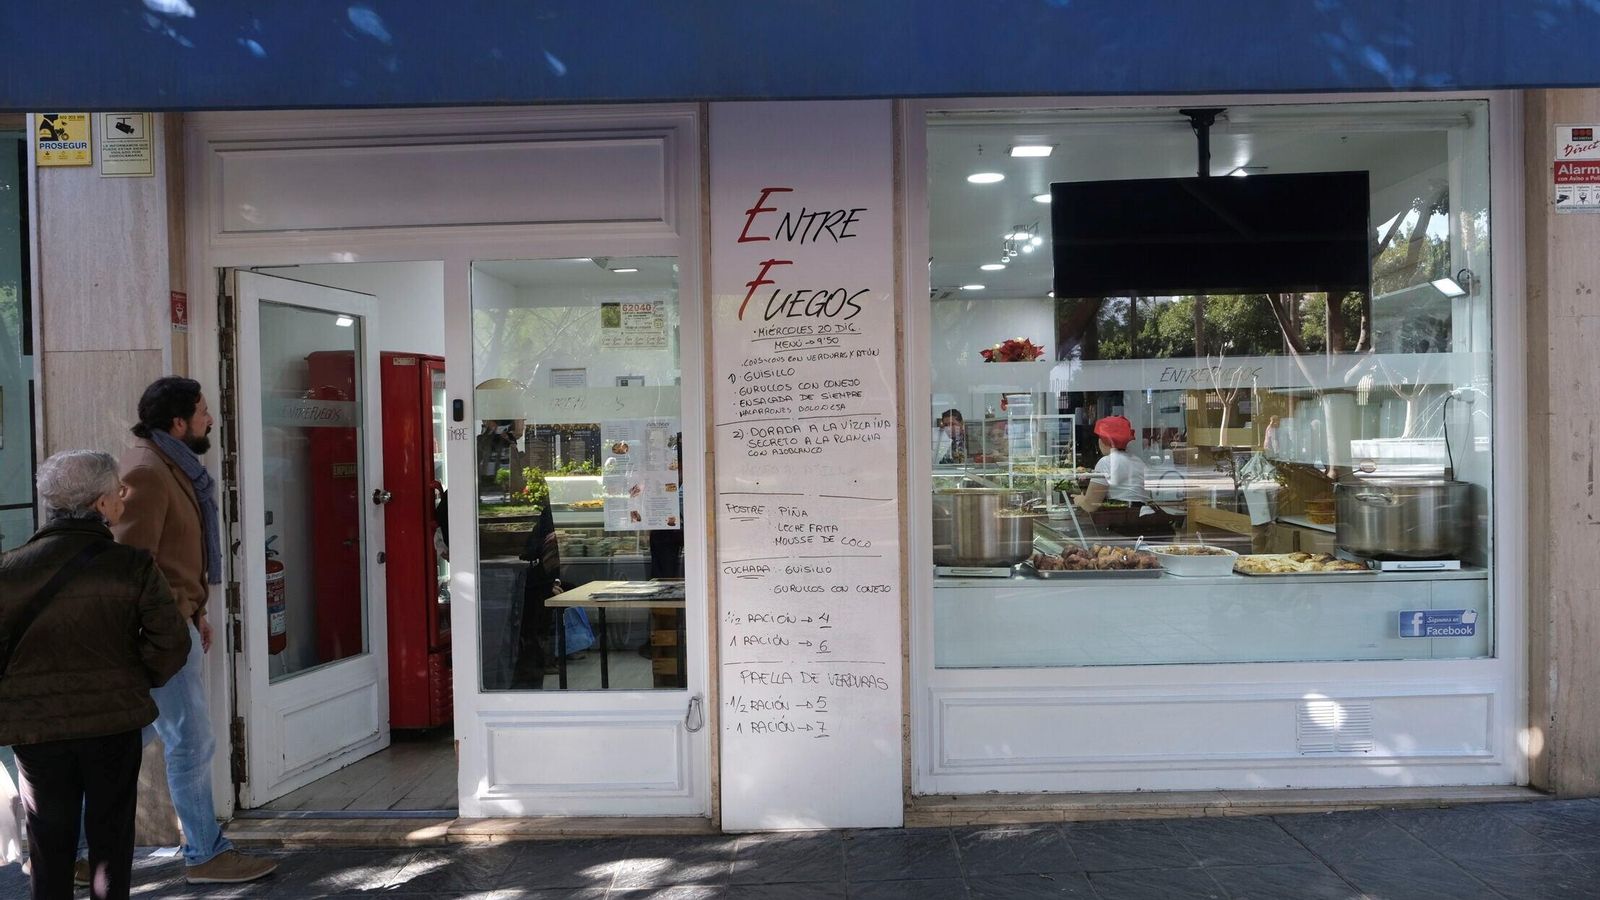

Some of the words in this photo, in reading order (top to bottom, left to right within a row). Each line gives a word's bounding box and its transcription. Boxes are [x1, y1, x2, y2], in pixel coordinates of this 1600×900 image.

[40, 142, 88, 150] PROSEGUR
[738, 187, 868, 245] ENTRE
[738, 259, 870, 321] FUEGOS
[622, 304, 652, 312] 62040
[818, 324, 832, 334] 20
[798, 382, 818, 390] CON
[824, 378, 861, 388] CONEJO
[800, 393, 814, 401] DE
[821, 390, 862, 400] SIEMPRE
[750, 424, 801, 438] DORADA
[809, 424, 819, 433] A
[823, 421, 838, 431] LA
[749, 437, 798, 449] SECRETO
[804, 436, 812, 445] A
[816, 436, 830, 445] LA
[834, 432, 881, 444] PLANCHA
[778, 506, 808, 518] PIÑA
[778, 523, 804, 533] LECHE
[809, 524, 839, 533] FRITA
[775, 536, 815, 546] MOUSSE
[821, 535, 835, 543] DE
[840, 537, 871, 548] COCO
[831, 585, 849, 593] CON
[856, 584, 892, 593] CONEJO
[819, 612, 830, 624] 4
[1427, 625, 1472, 635] Facebook
[819, 640, 828, 652] 6
[740, 670, 793, 685] PAELLA
[800, 671, 820, 684] DE
[828, 673, 888, 690] VERDURAS
[750, 695, 790, 711] RACIÓN
[816, 696, 828, 709] 5
[737, 722, 743, 734] 1
[751, 715, 795, 733] RACIÓN
[816, 721, 827, 733] 7
